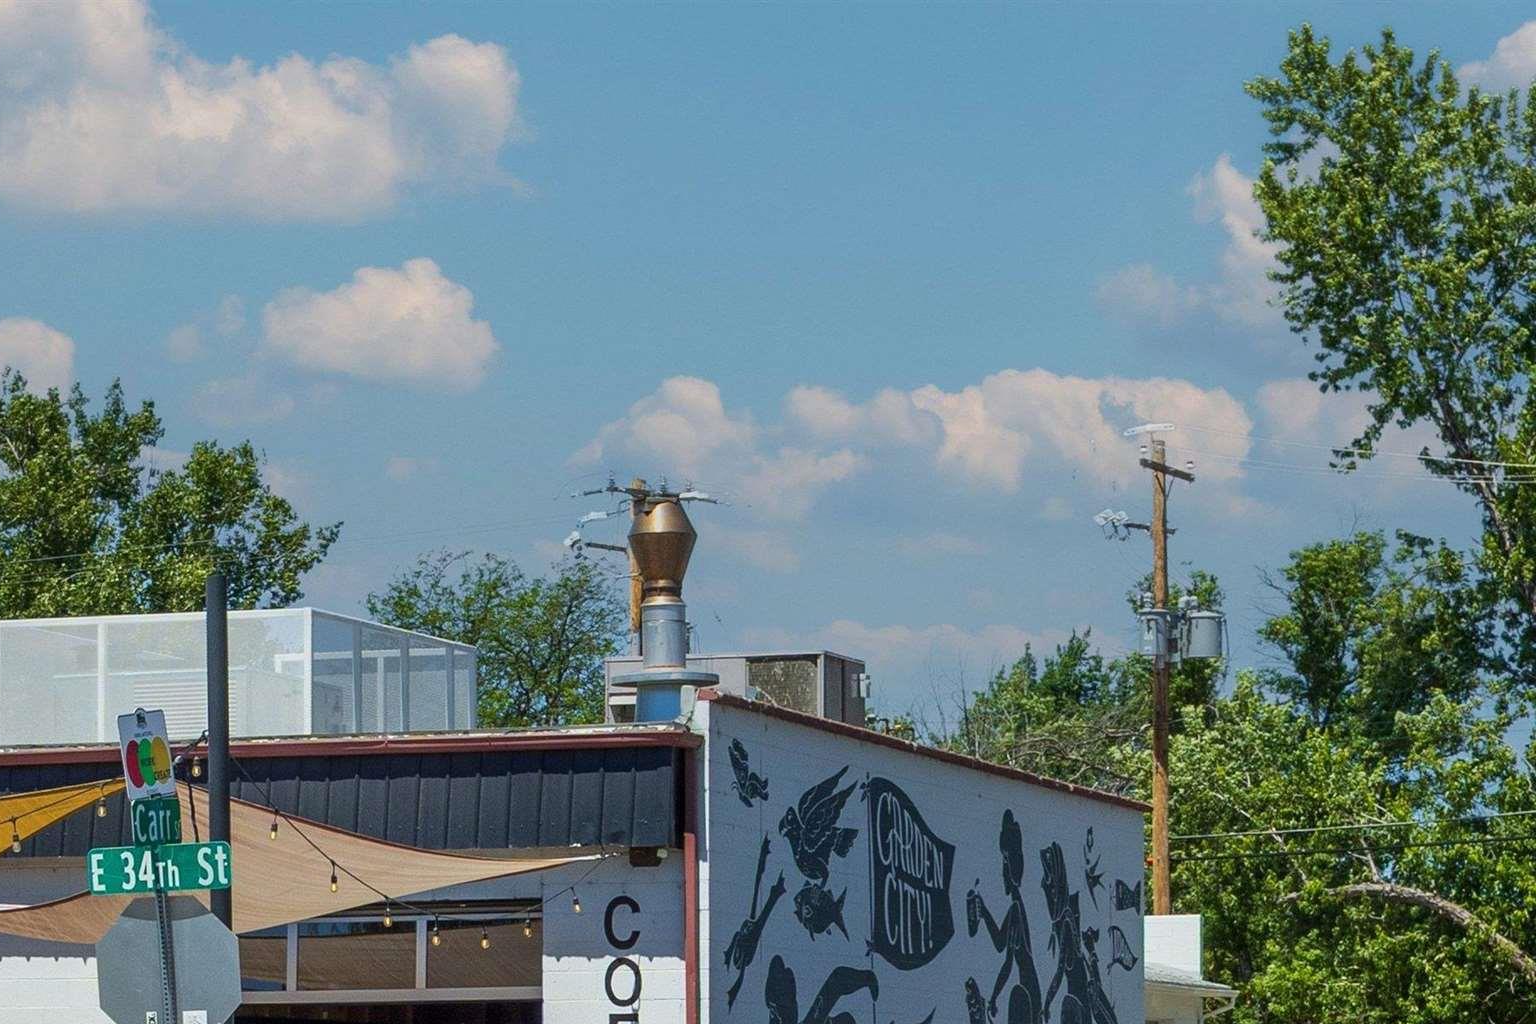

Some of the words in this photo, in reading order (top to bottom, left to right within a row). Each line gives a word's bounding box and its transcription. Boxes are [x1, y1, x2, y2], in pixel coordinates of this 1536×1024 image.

[135, 803, 171, 843] Carr
[876, 792, 944, 890] GARDEN
[90, 853, 106, 892] E
[197, 845, 229, 887] St
[884, 871, 934, 955] CITY!
